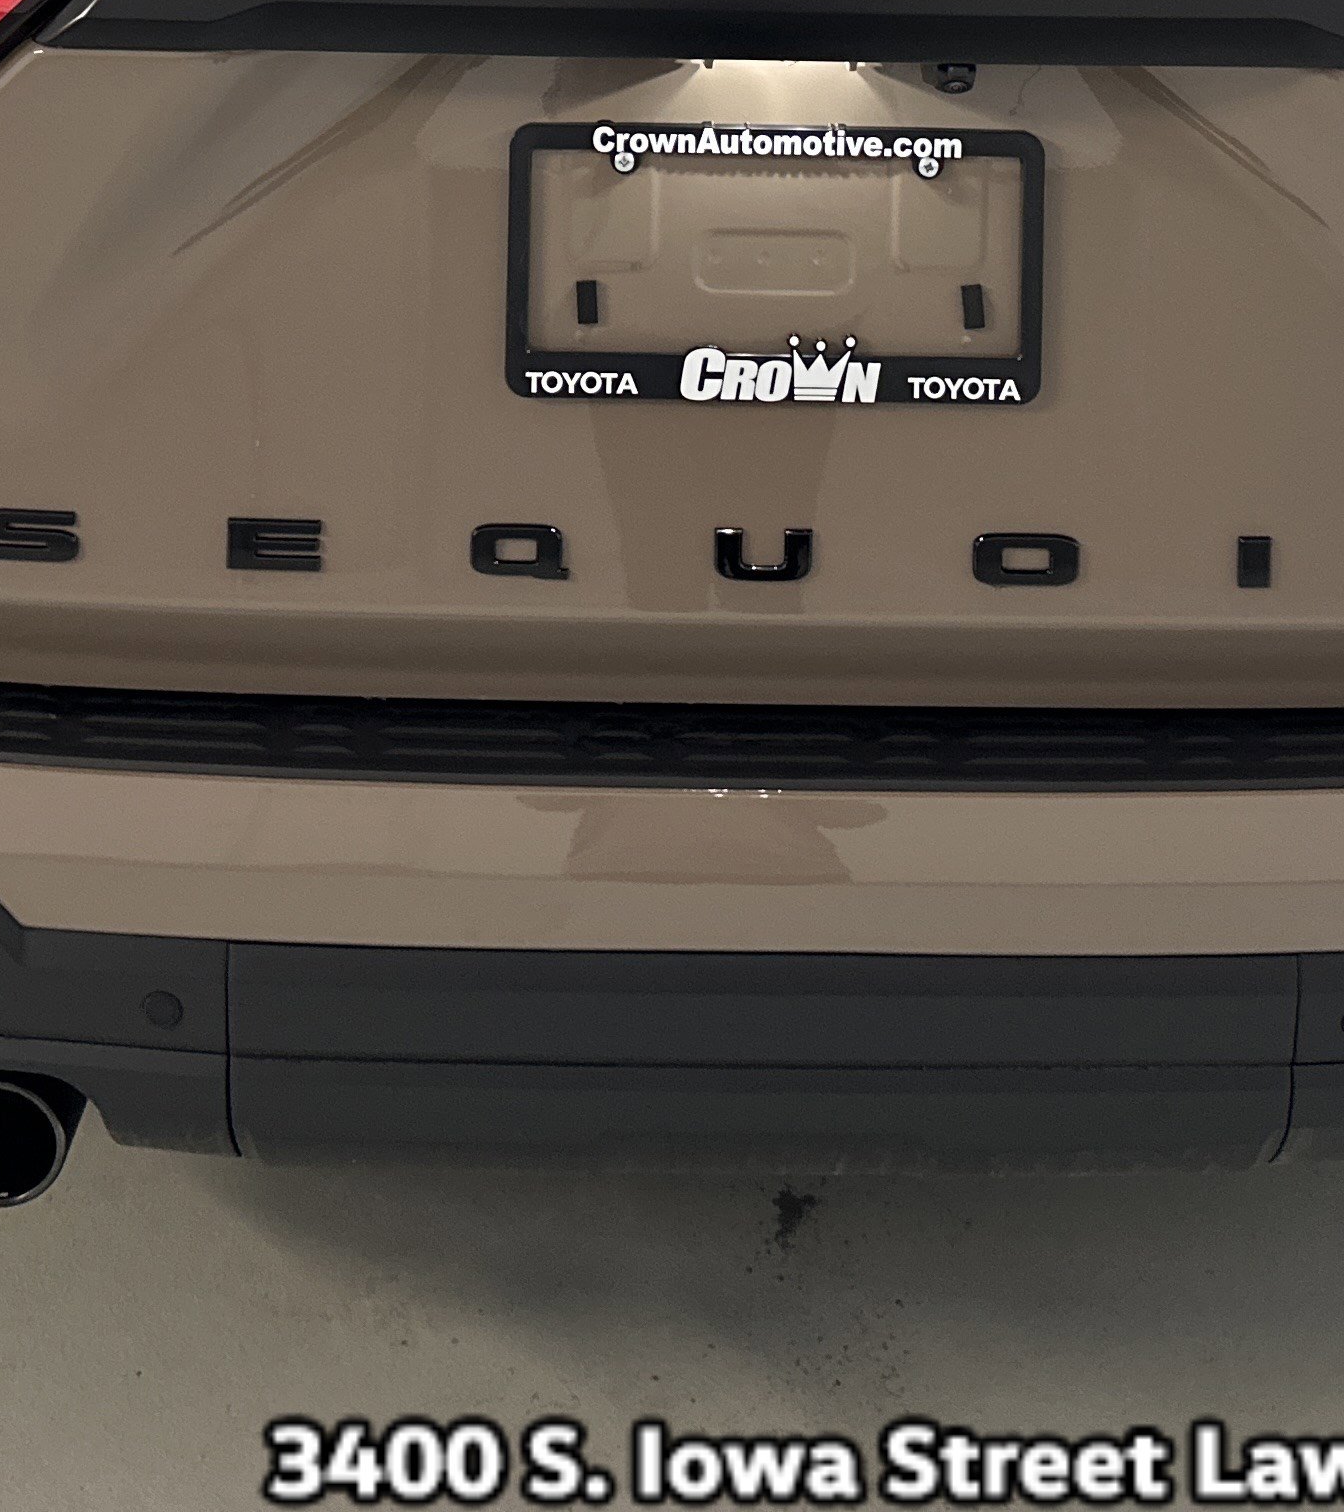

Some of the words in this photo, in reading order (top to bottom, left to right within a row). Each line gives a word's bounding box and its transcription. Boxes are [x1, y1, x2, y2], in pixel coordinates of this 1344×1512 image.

[592, 126, 962, 159] CrownAutomotive.com
[526, 371, 638, 396] TOYOTA
[908, 376, 1021, 401] TOYOTA
